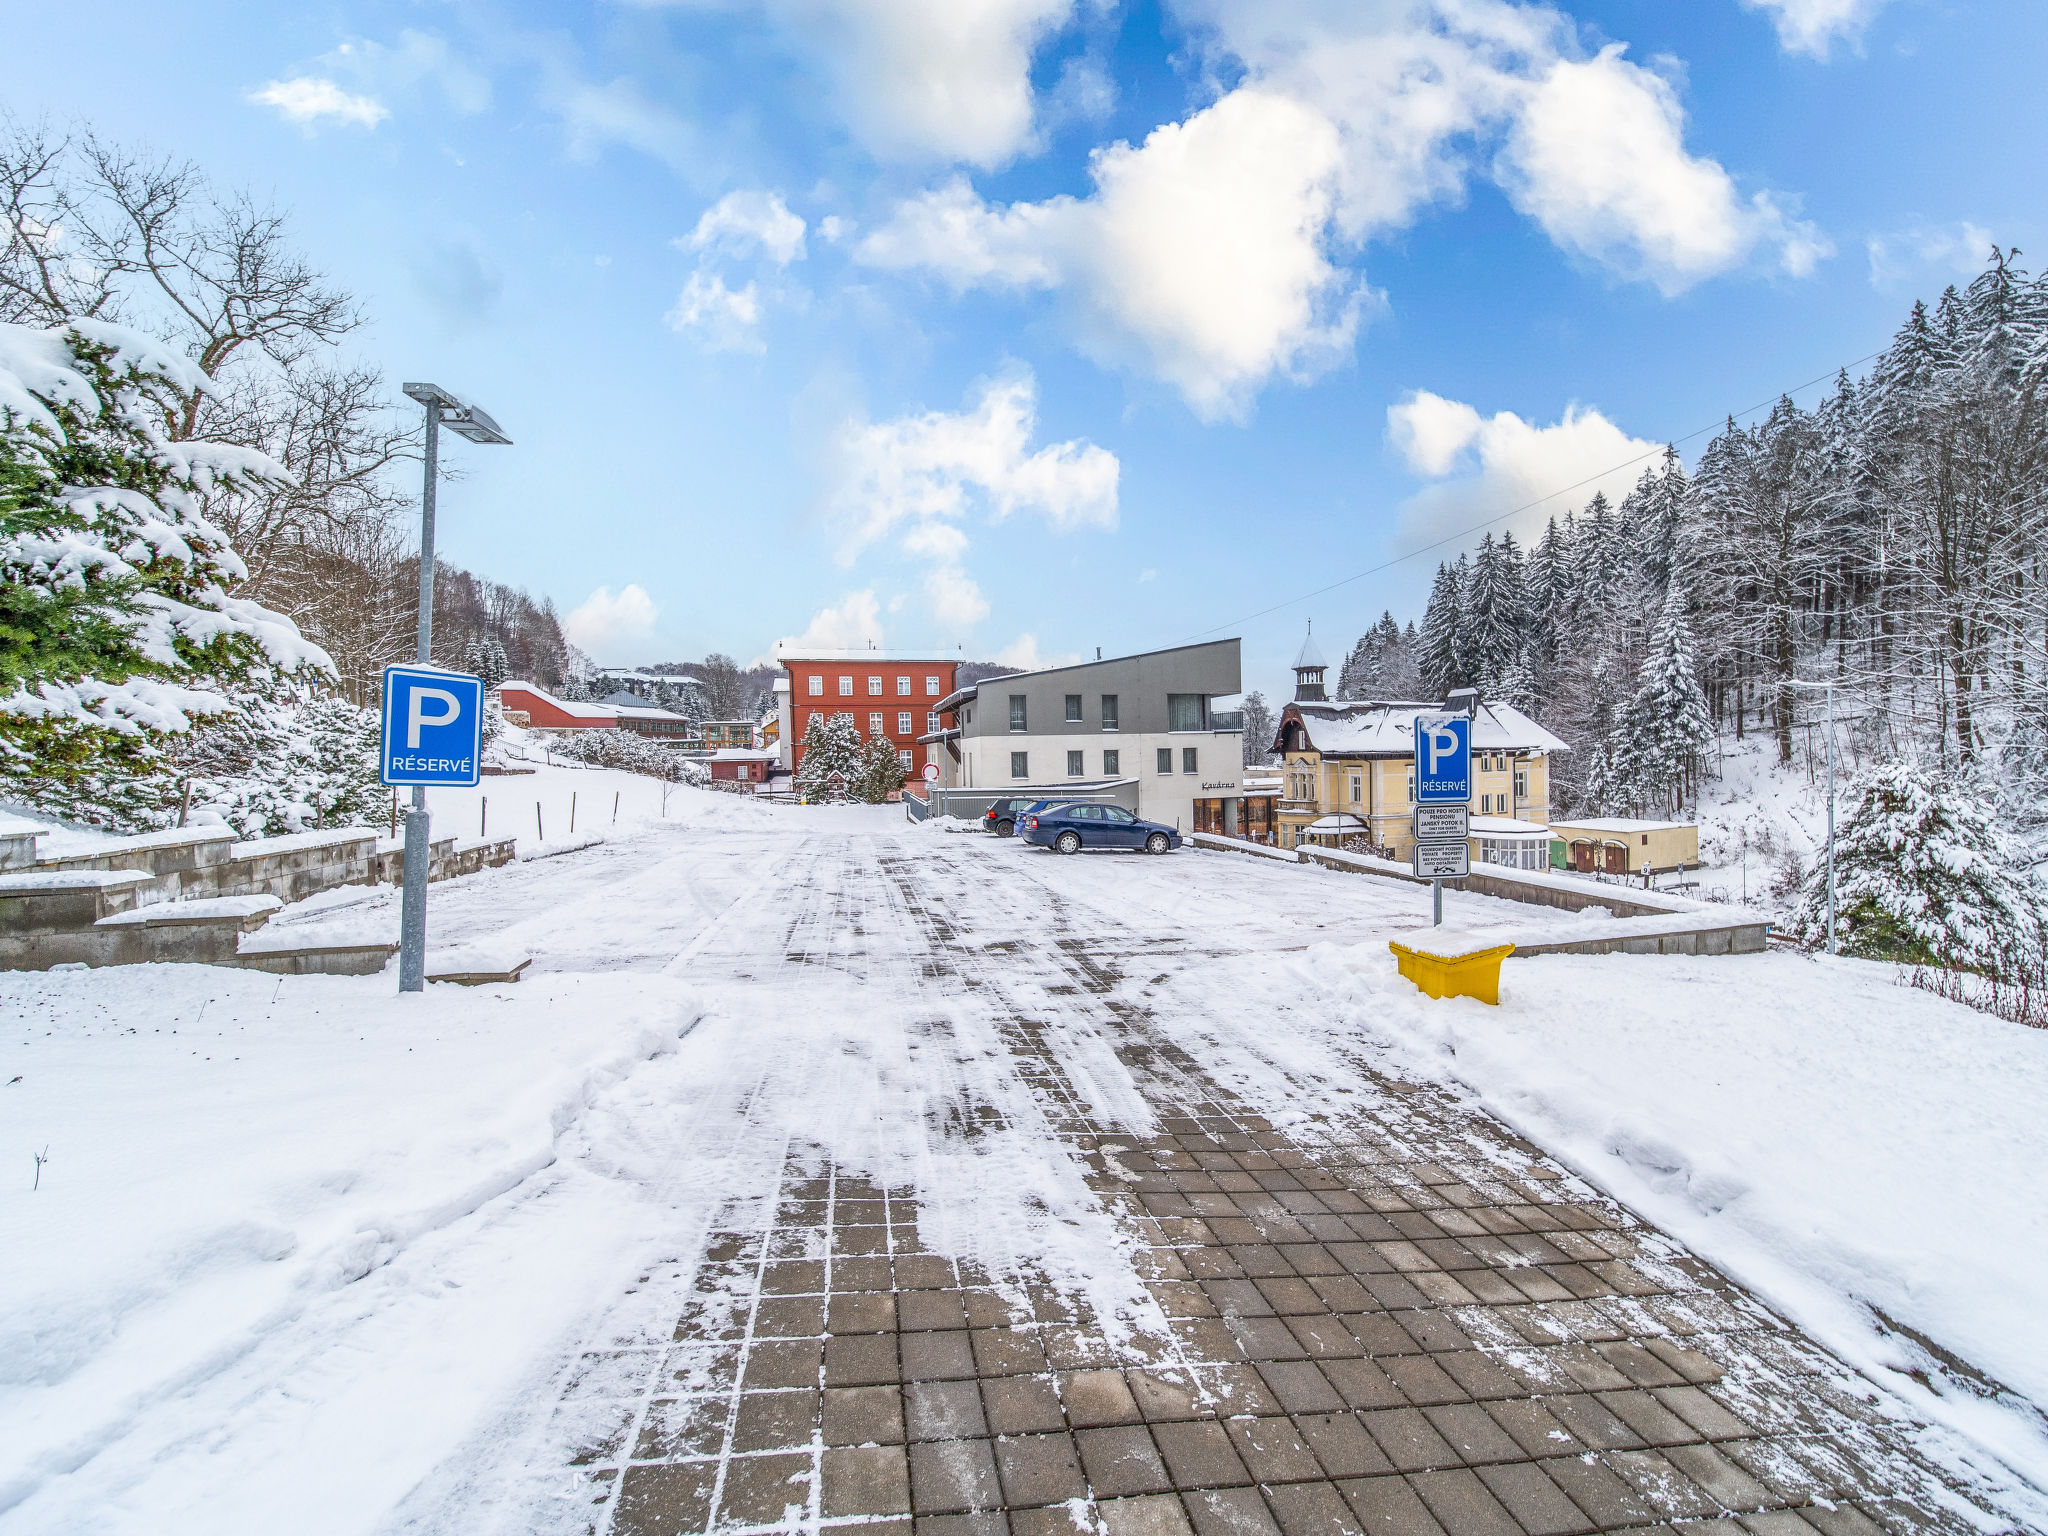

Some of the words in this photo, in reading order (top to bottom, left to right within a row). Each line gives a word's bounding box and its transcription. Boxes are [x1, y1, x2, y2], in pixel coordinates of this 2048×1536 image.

[406, 685, 461, 749] P
[1429, 728, 1459, 775] P
[392, 754, 471, 773] RÉSERVÉ
[1201, 780, 1235, 791] Kavárna
[1422, 779, 1466, 792] RÉSERVÉ
